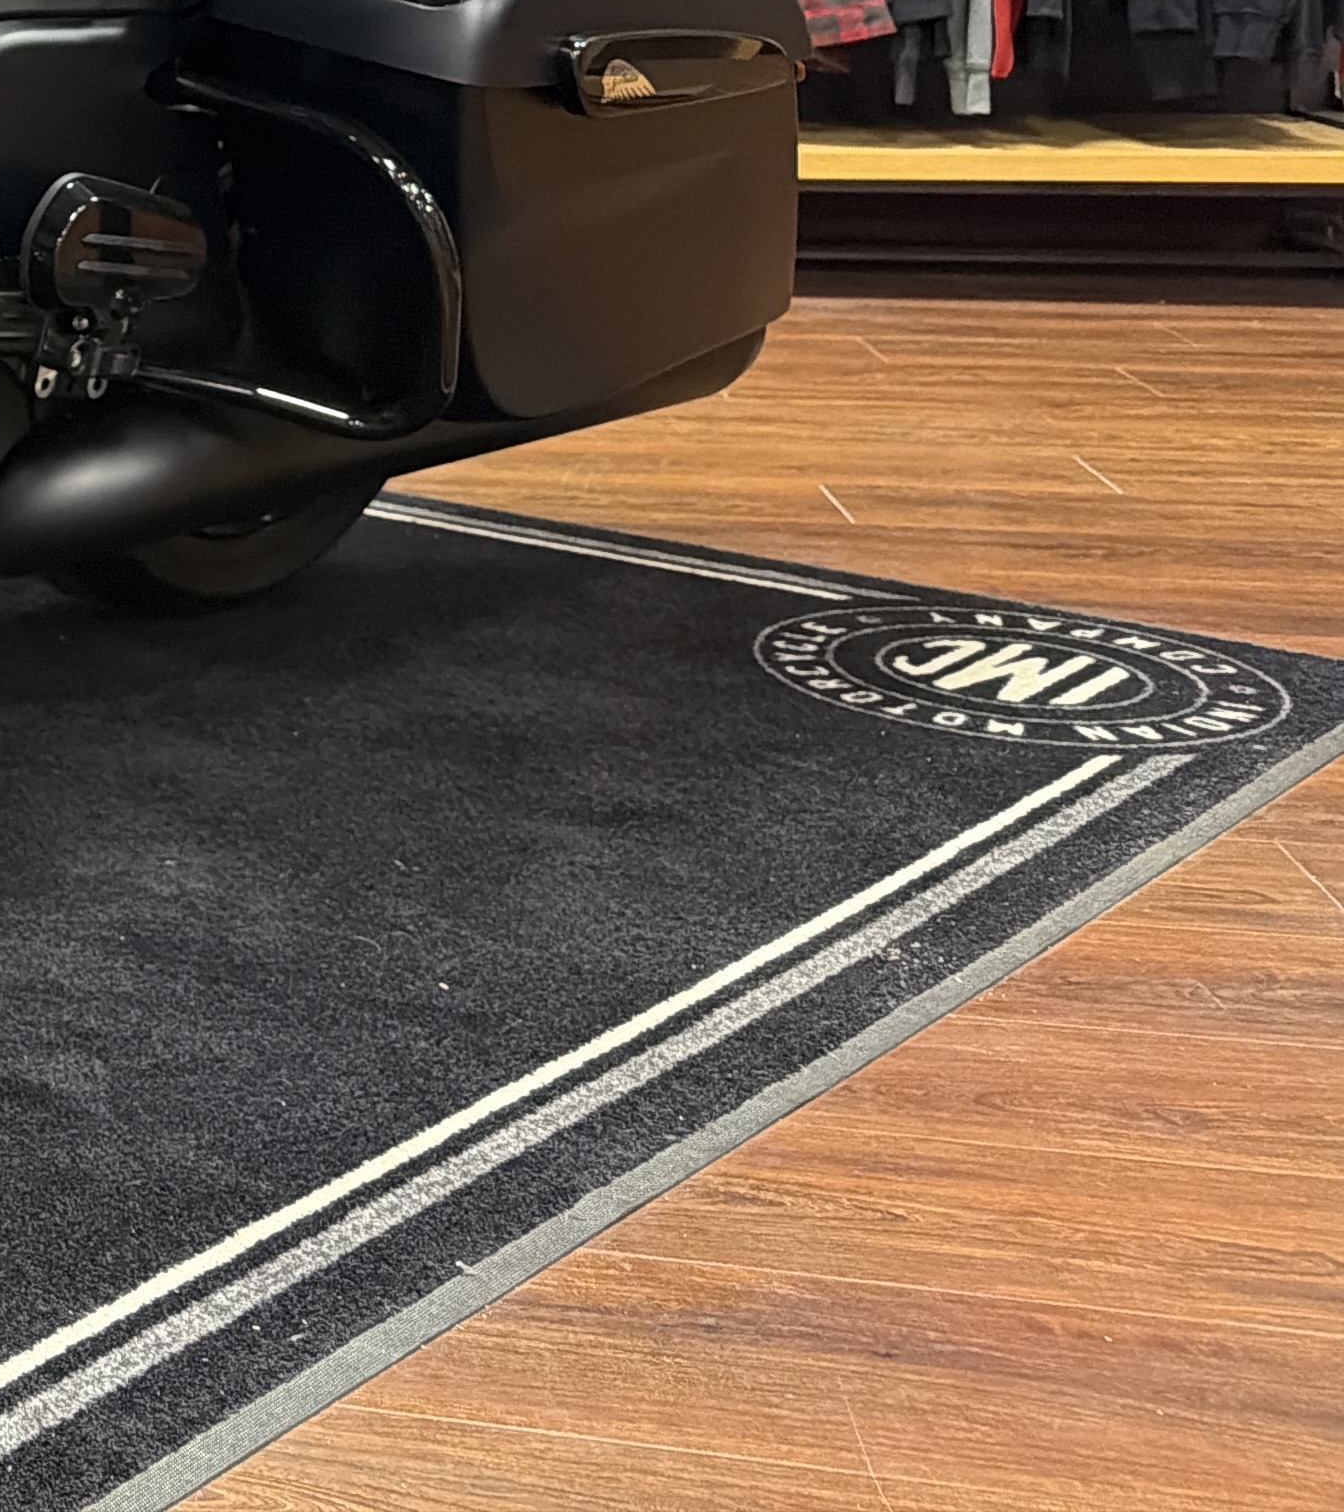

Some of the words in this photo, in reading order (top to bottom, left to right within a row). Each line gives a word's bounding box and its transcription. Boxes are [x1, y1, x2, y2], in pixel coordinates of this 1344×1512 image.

[892, 639, 1131, 705] IMC
[929, 611, 1238, 675] COMPANY
[771, 621, 1025, 737] MOTORCYCLE
[1072, 700, 1266, 742] INDIAN
